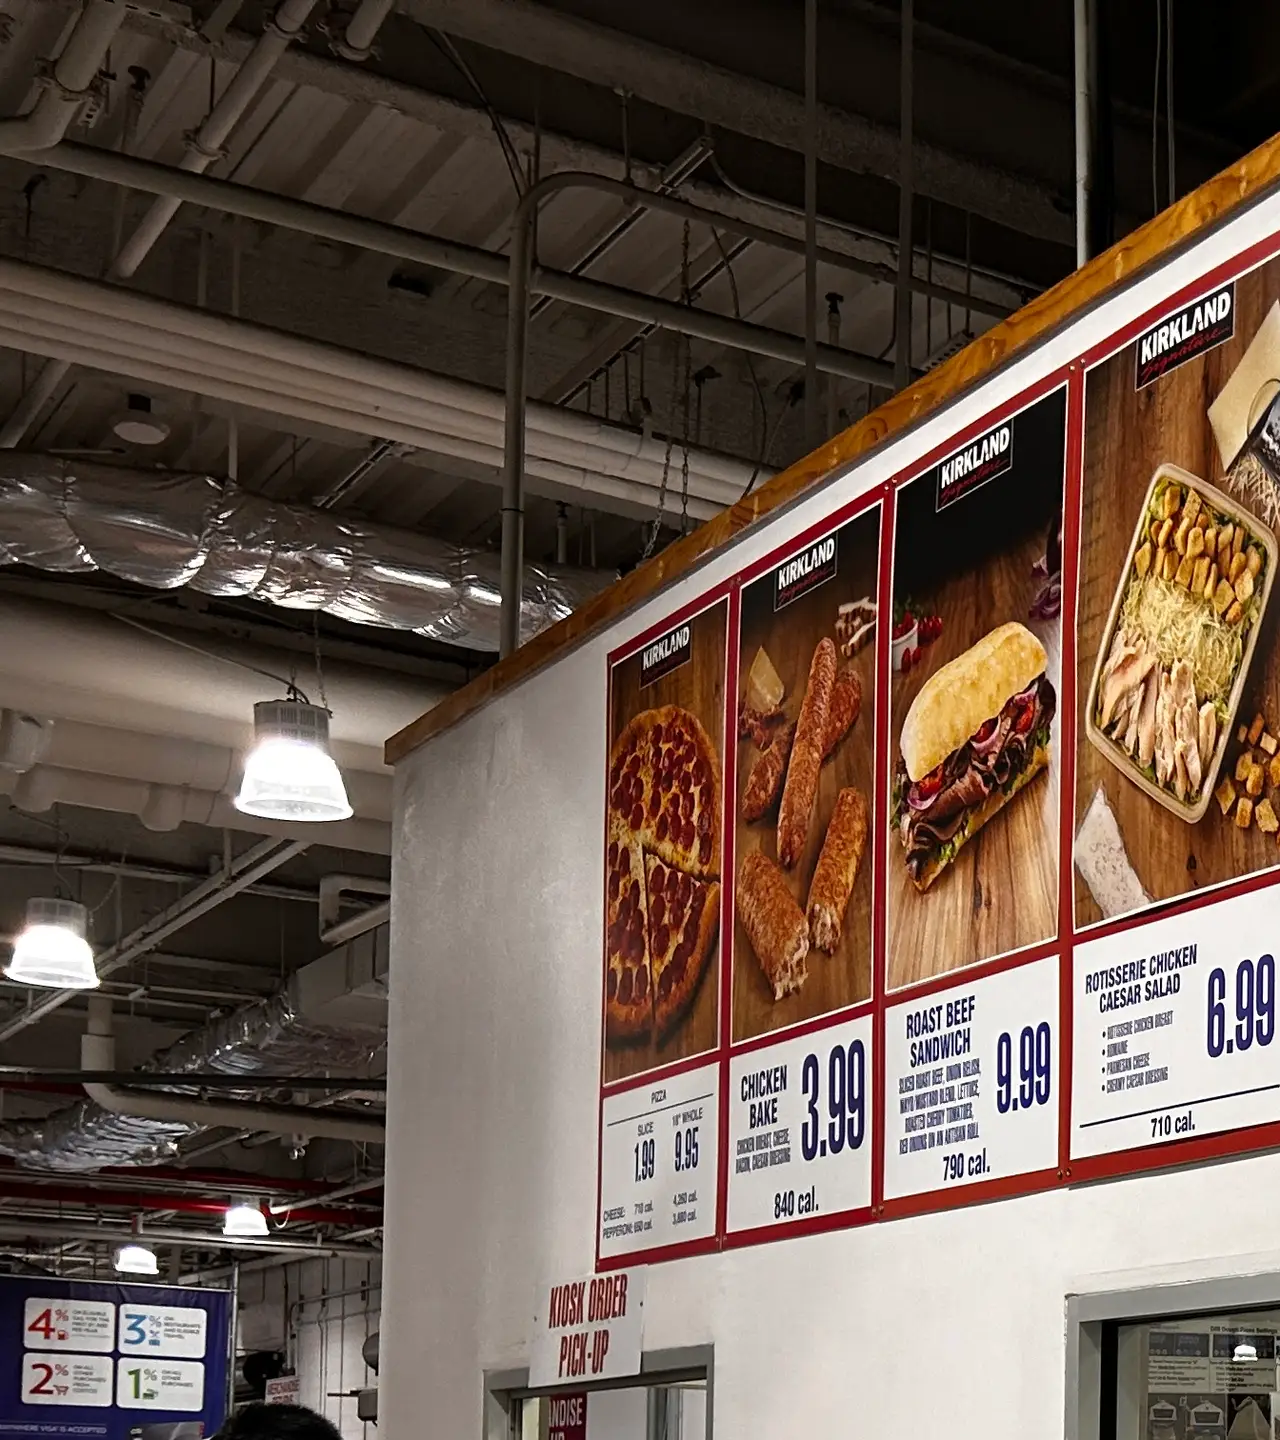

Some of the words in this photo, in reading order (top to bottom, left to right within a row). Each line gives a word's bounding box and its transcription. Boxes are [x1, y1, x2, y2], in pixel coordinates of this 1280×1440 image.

[1140, 290, 1231, 365] KIRKLAND
[940, 427, 1009, 488] KIRKLAND
[778, 538, 835, 589] KIRKLAND
[642, 625, 689, 671] KIRKLAND
[1085, 962, 1146, 994] ROTISSERIE
[1149, 943, 1197, 976] CHICKEN
[1099, 982, 1142, 1013] CAESAR
[1144, 973, 1180, 1004] SALAD
[1207, 954, 1275, 1058] 6.99
[906, 1006, 942, 1040] ROAST
[946, 995, 975, 1025] BEEF
[910, 1028, 971, 1069] SANDWICH
[996, 1021, 1050, 1115] 9.99
[651, 1090, 666, 1103] PIZZA
[741, 1066, 787, 1101] CHICKEN
[801, 1040, 865, 1161] 3.99
[749, 1099, 777, 1130] BAKE
[1150, 1115, 1171, 1138] 710
[1174, 1110, 1196, 1135] cal.
[634, 1139, 655, 1182] 1.99
[675, 1127, 699, 1172] 9.95
[943, 1153, 965, 1181] 790
[968, 1148, 990, 1176] cal.
[774, 1190, 794, 1219] 840
[798, 1185, 818, 1215] cal.
[549, 1281, 586, 1329] KIOSK
[588, 1273, 628, 1323] ORDER
[559, 1329, 609, 1378] PICK-UP
